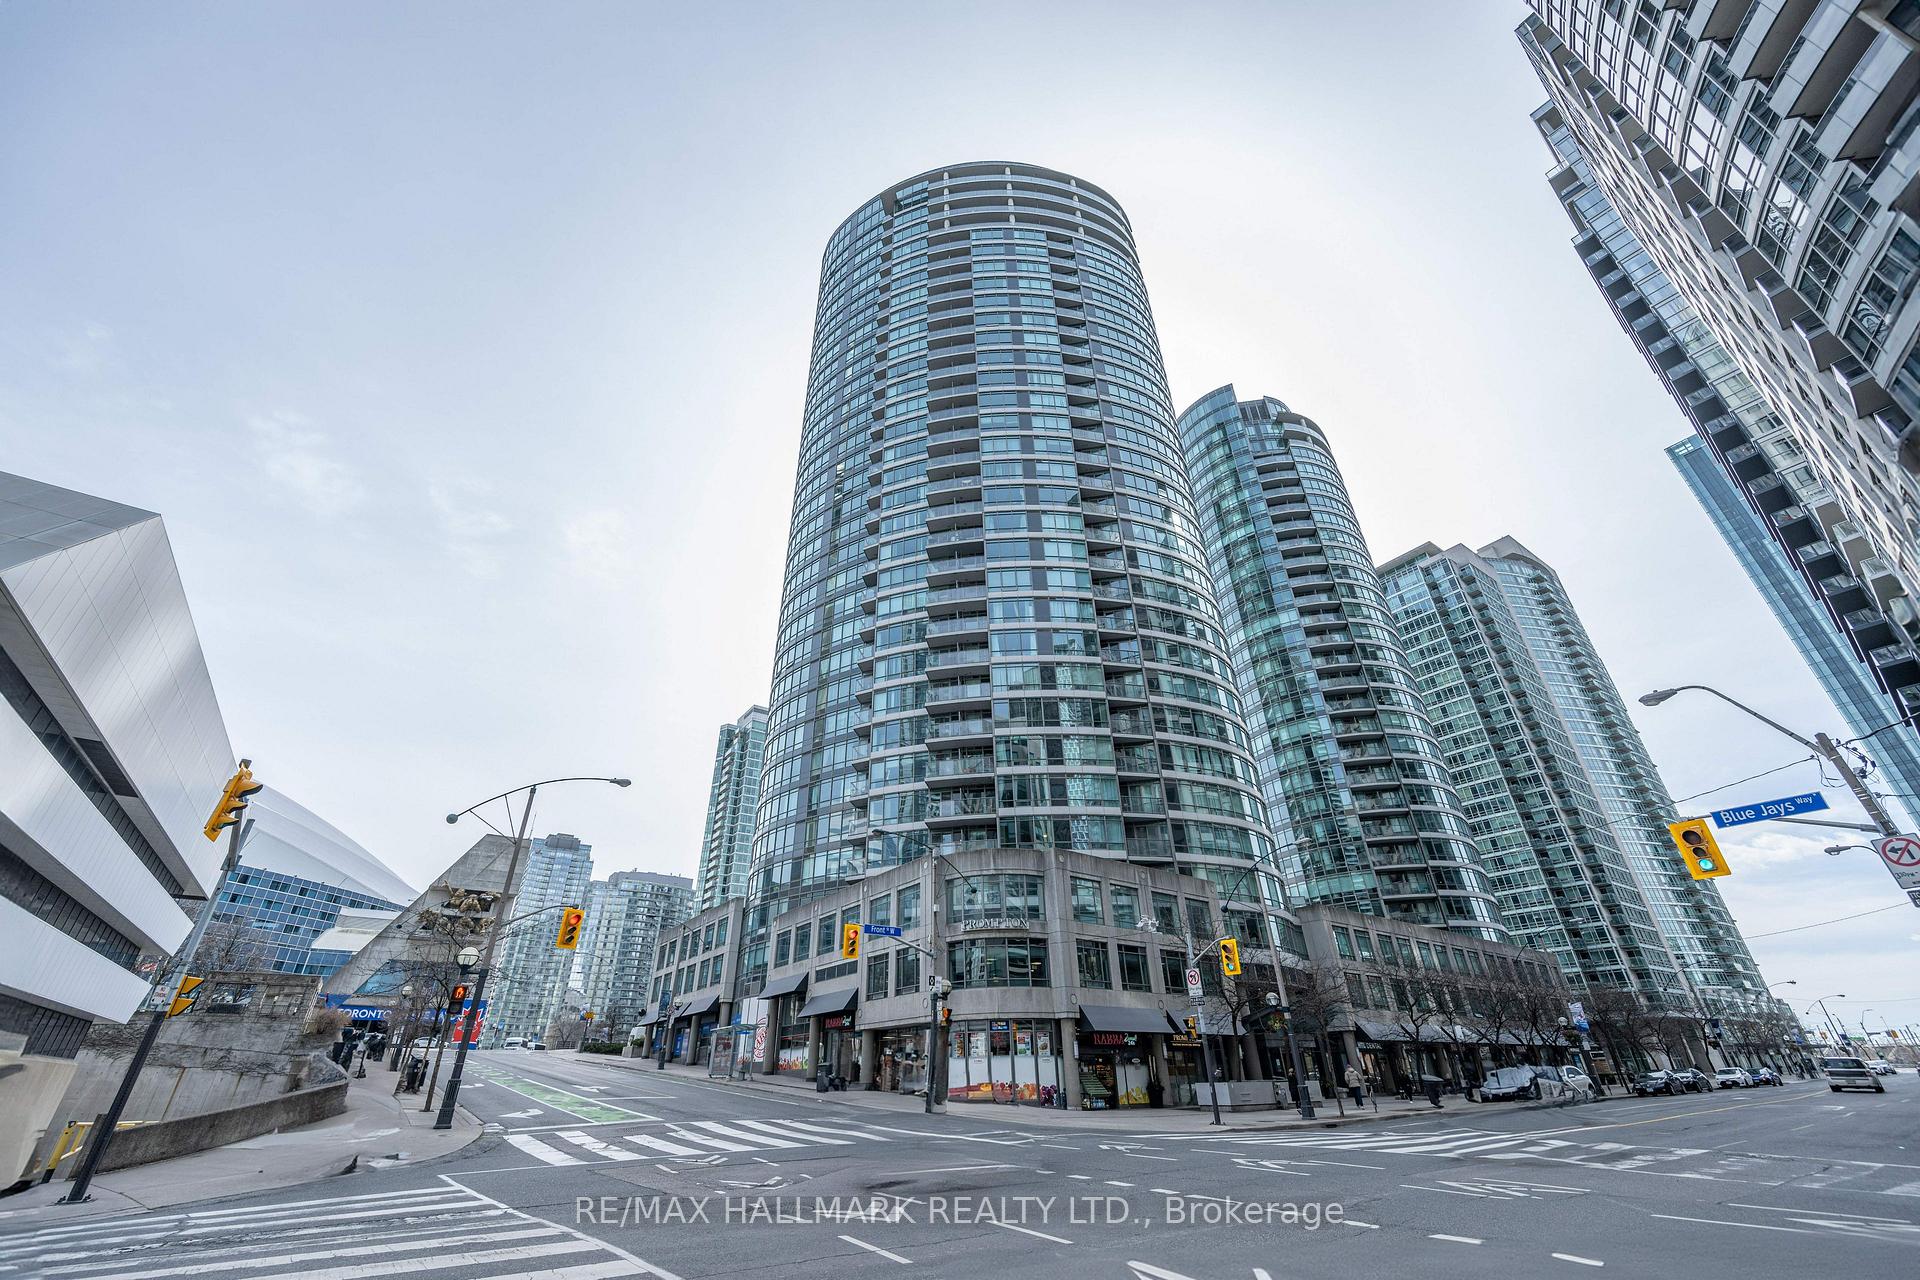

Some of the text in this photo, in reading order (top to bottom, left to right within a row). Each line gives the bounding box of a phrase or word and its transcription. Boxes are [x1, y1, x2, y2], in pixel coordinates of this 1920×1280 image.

[1720, 796, 1813, 823] Blue Jays Way
[871, 925, 886, 934] Front
[962, 917, 1029, 930] PROMPTON
[1093, 1033, 1124, 1045] RABBA
